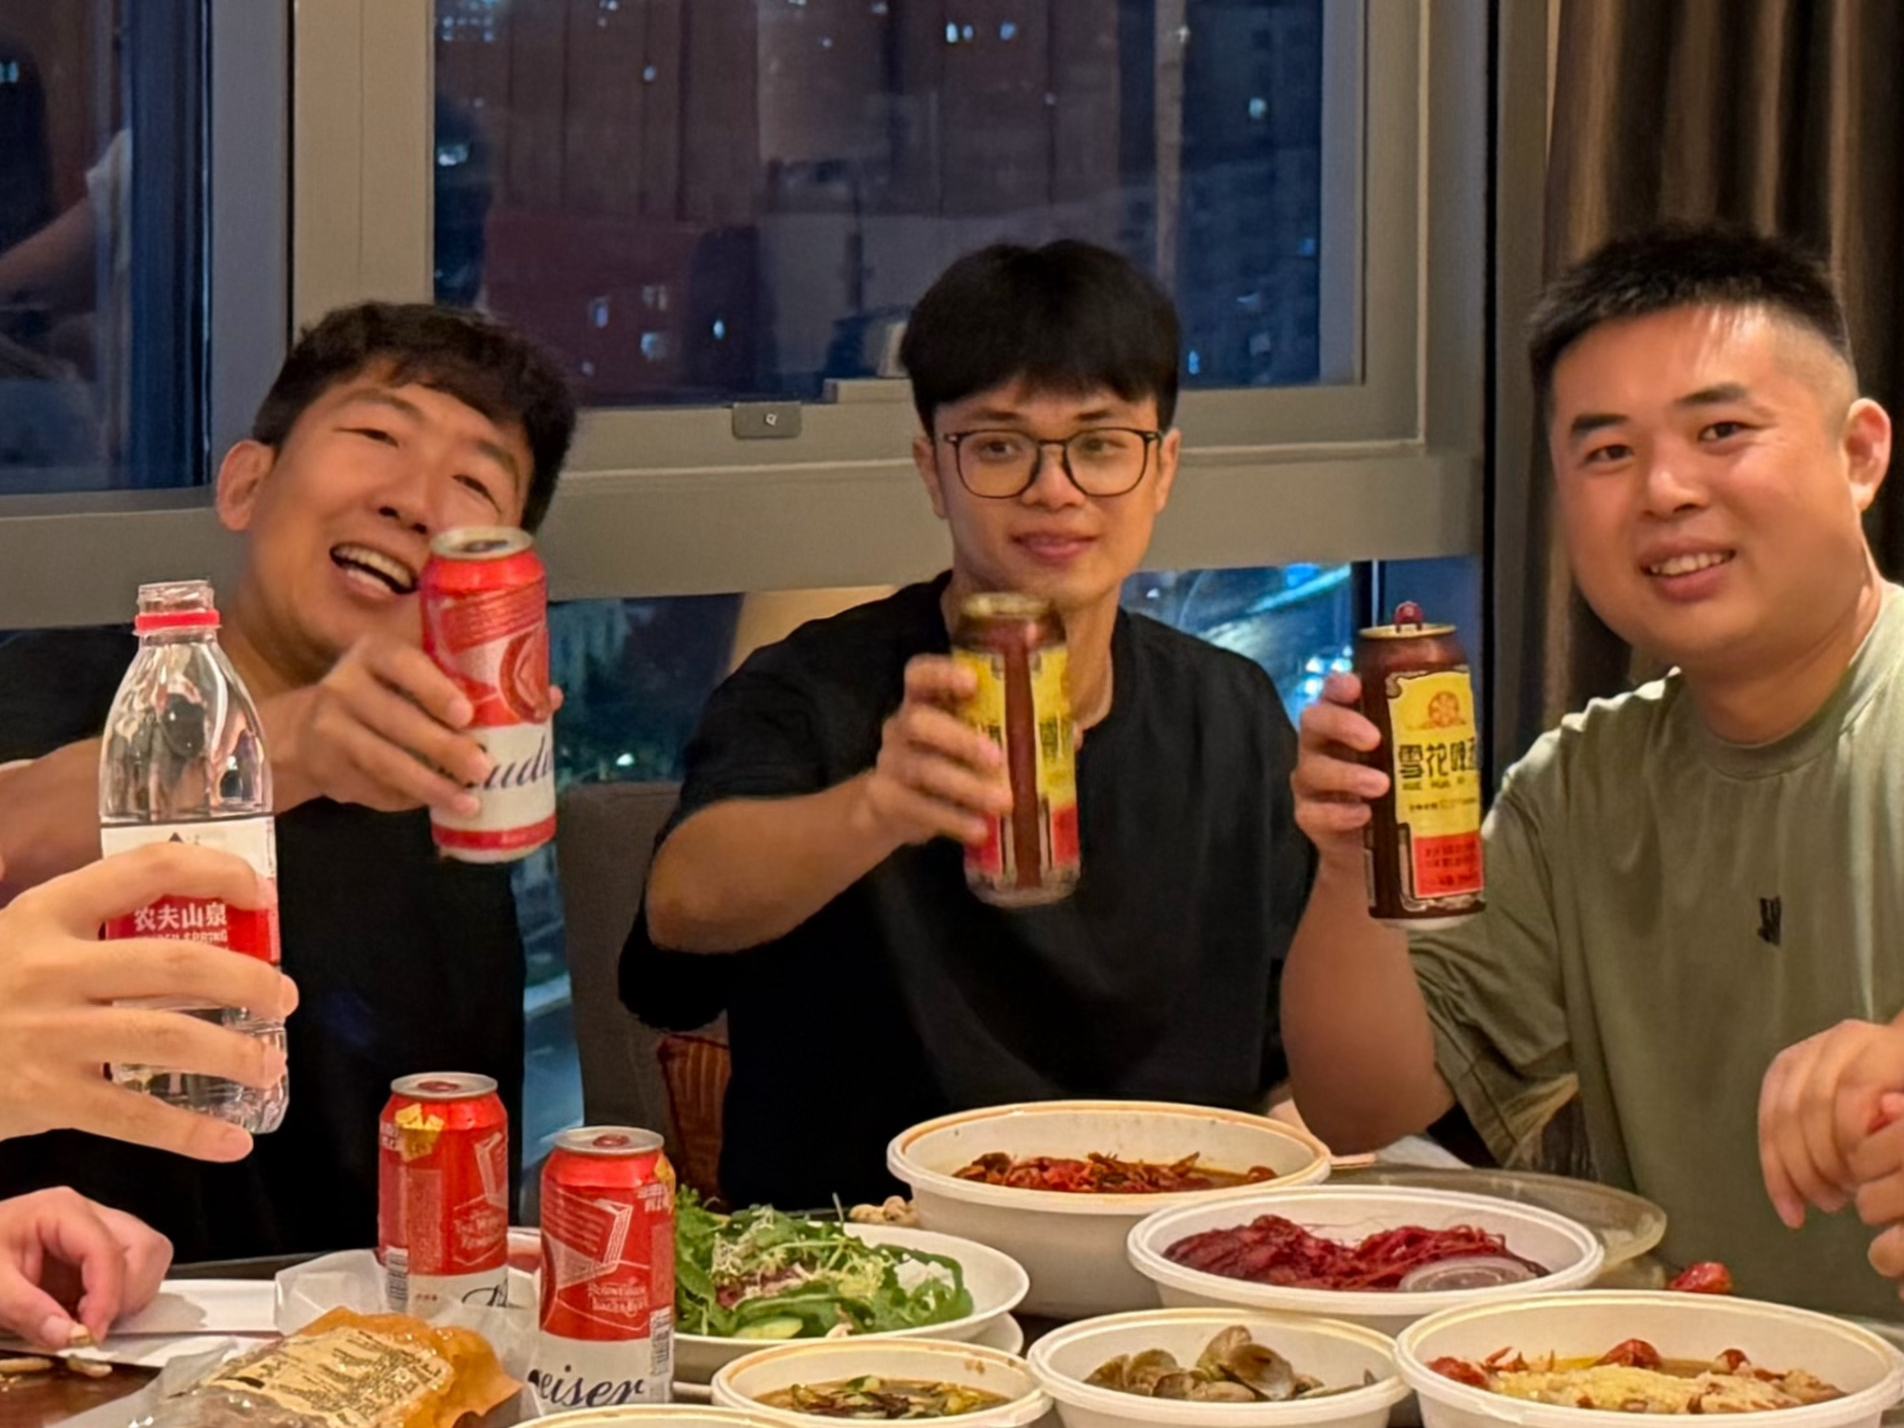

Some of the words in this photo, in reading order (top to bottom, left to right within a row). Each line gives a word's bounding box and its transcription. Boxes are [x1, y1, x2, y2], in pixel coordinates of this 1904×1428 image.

[481, 734, 554, 790] ud
[134, 901, 227, 932] 农夫山泉
